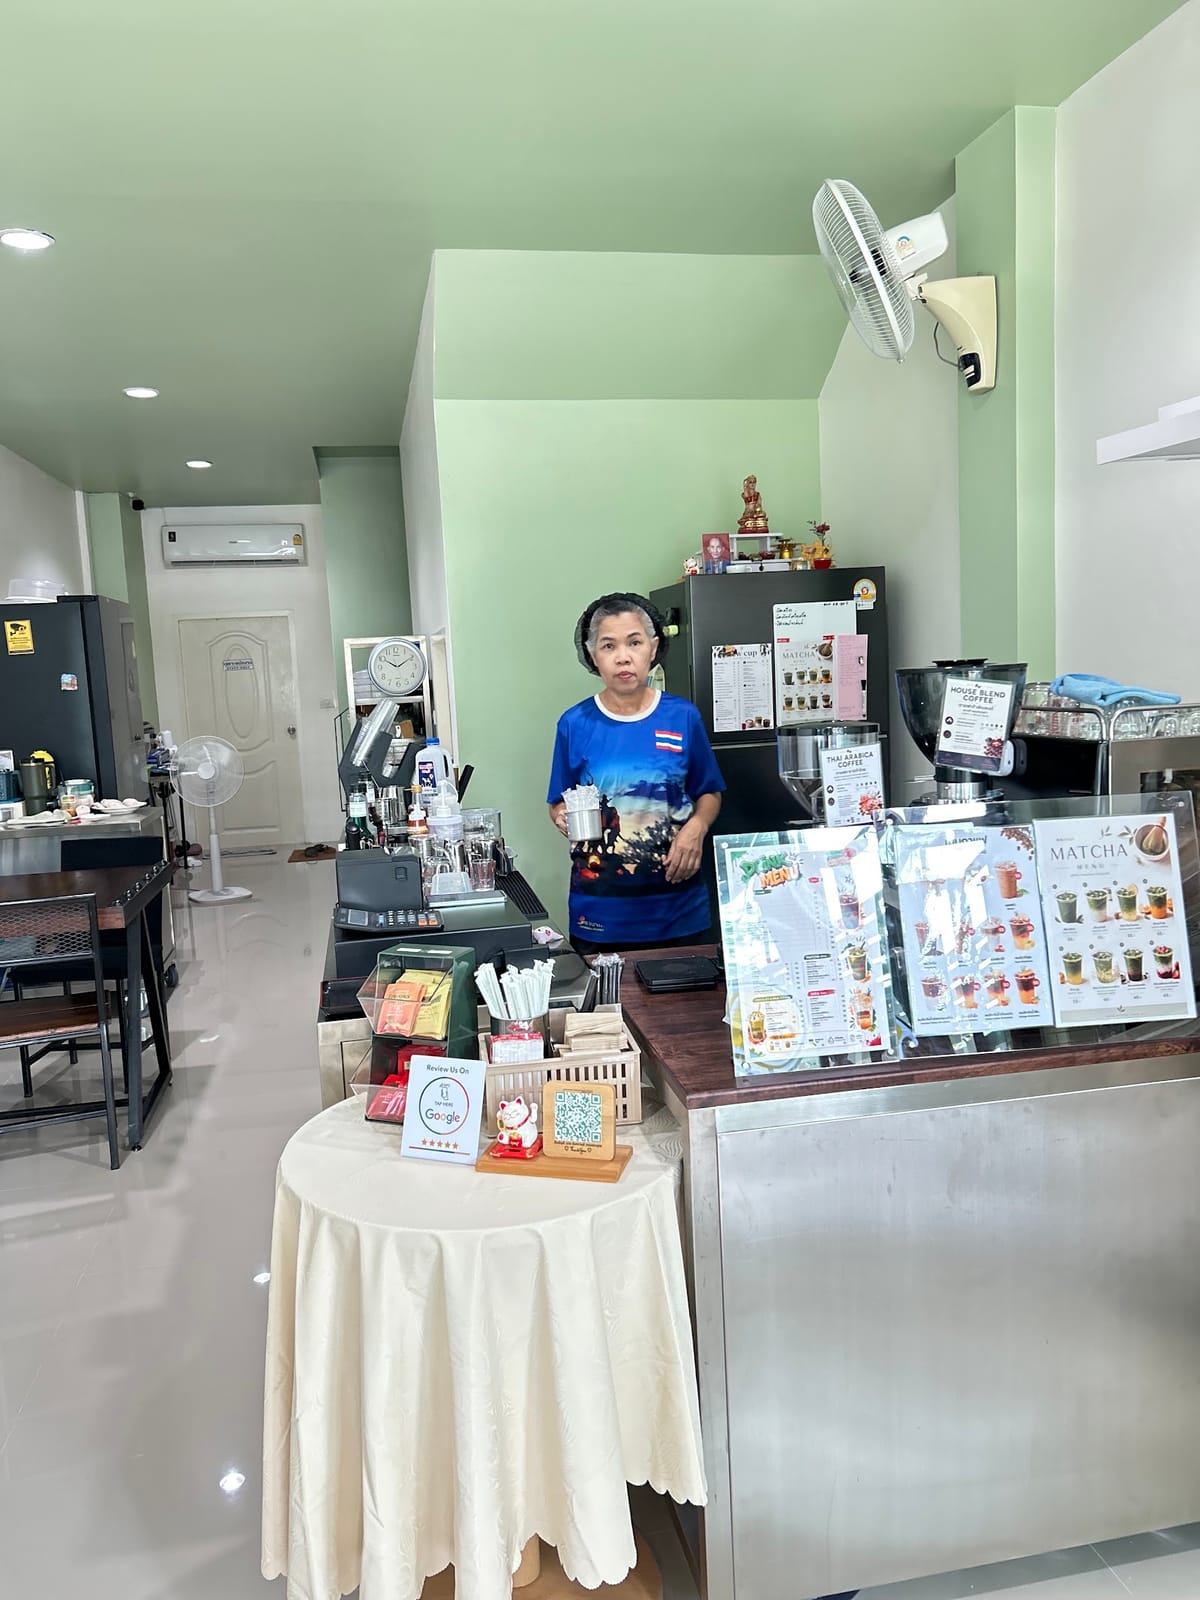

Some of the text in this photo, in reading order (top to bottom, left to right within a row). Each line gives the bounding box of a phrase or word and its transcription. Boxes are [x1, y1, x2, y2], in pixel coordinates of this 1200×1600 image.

[743, 650, 758, 658] cup
[782, 650, 816, 660] MATCHA
[950, 686, 1006, 698] HOUSE BLEND
[962, 694, 994, 704] COFFEE
[826, 751, 874, 763] THAI ARABICA
[837, 760, 863, 768] COFFEE
[1050, 843, 1129, 861] MATCHA
[760, 863, 802, 889] MENU
[426, 1064, 470, 1075] Review Us On
[425, 1108, 460, 1125] Google
